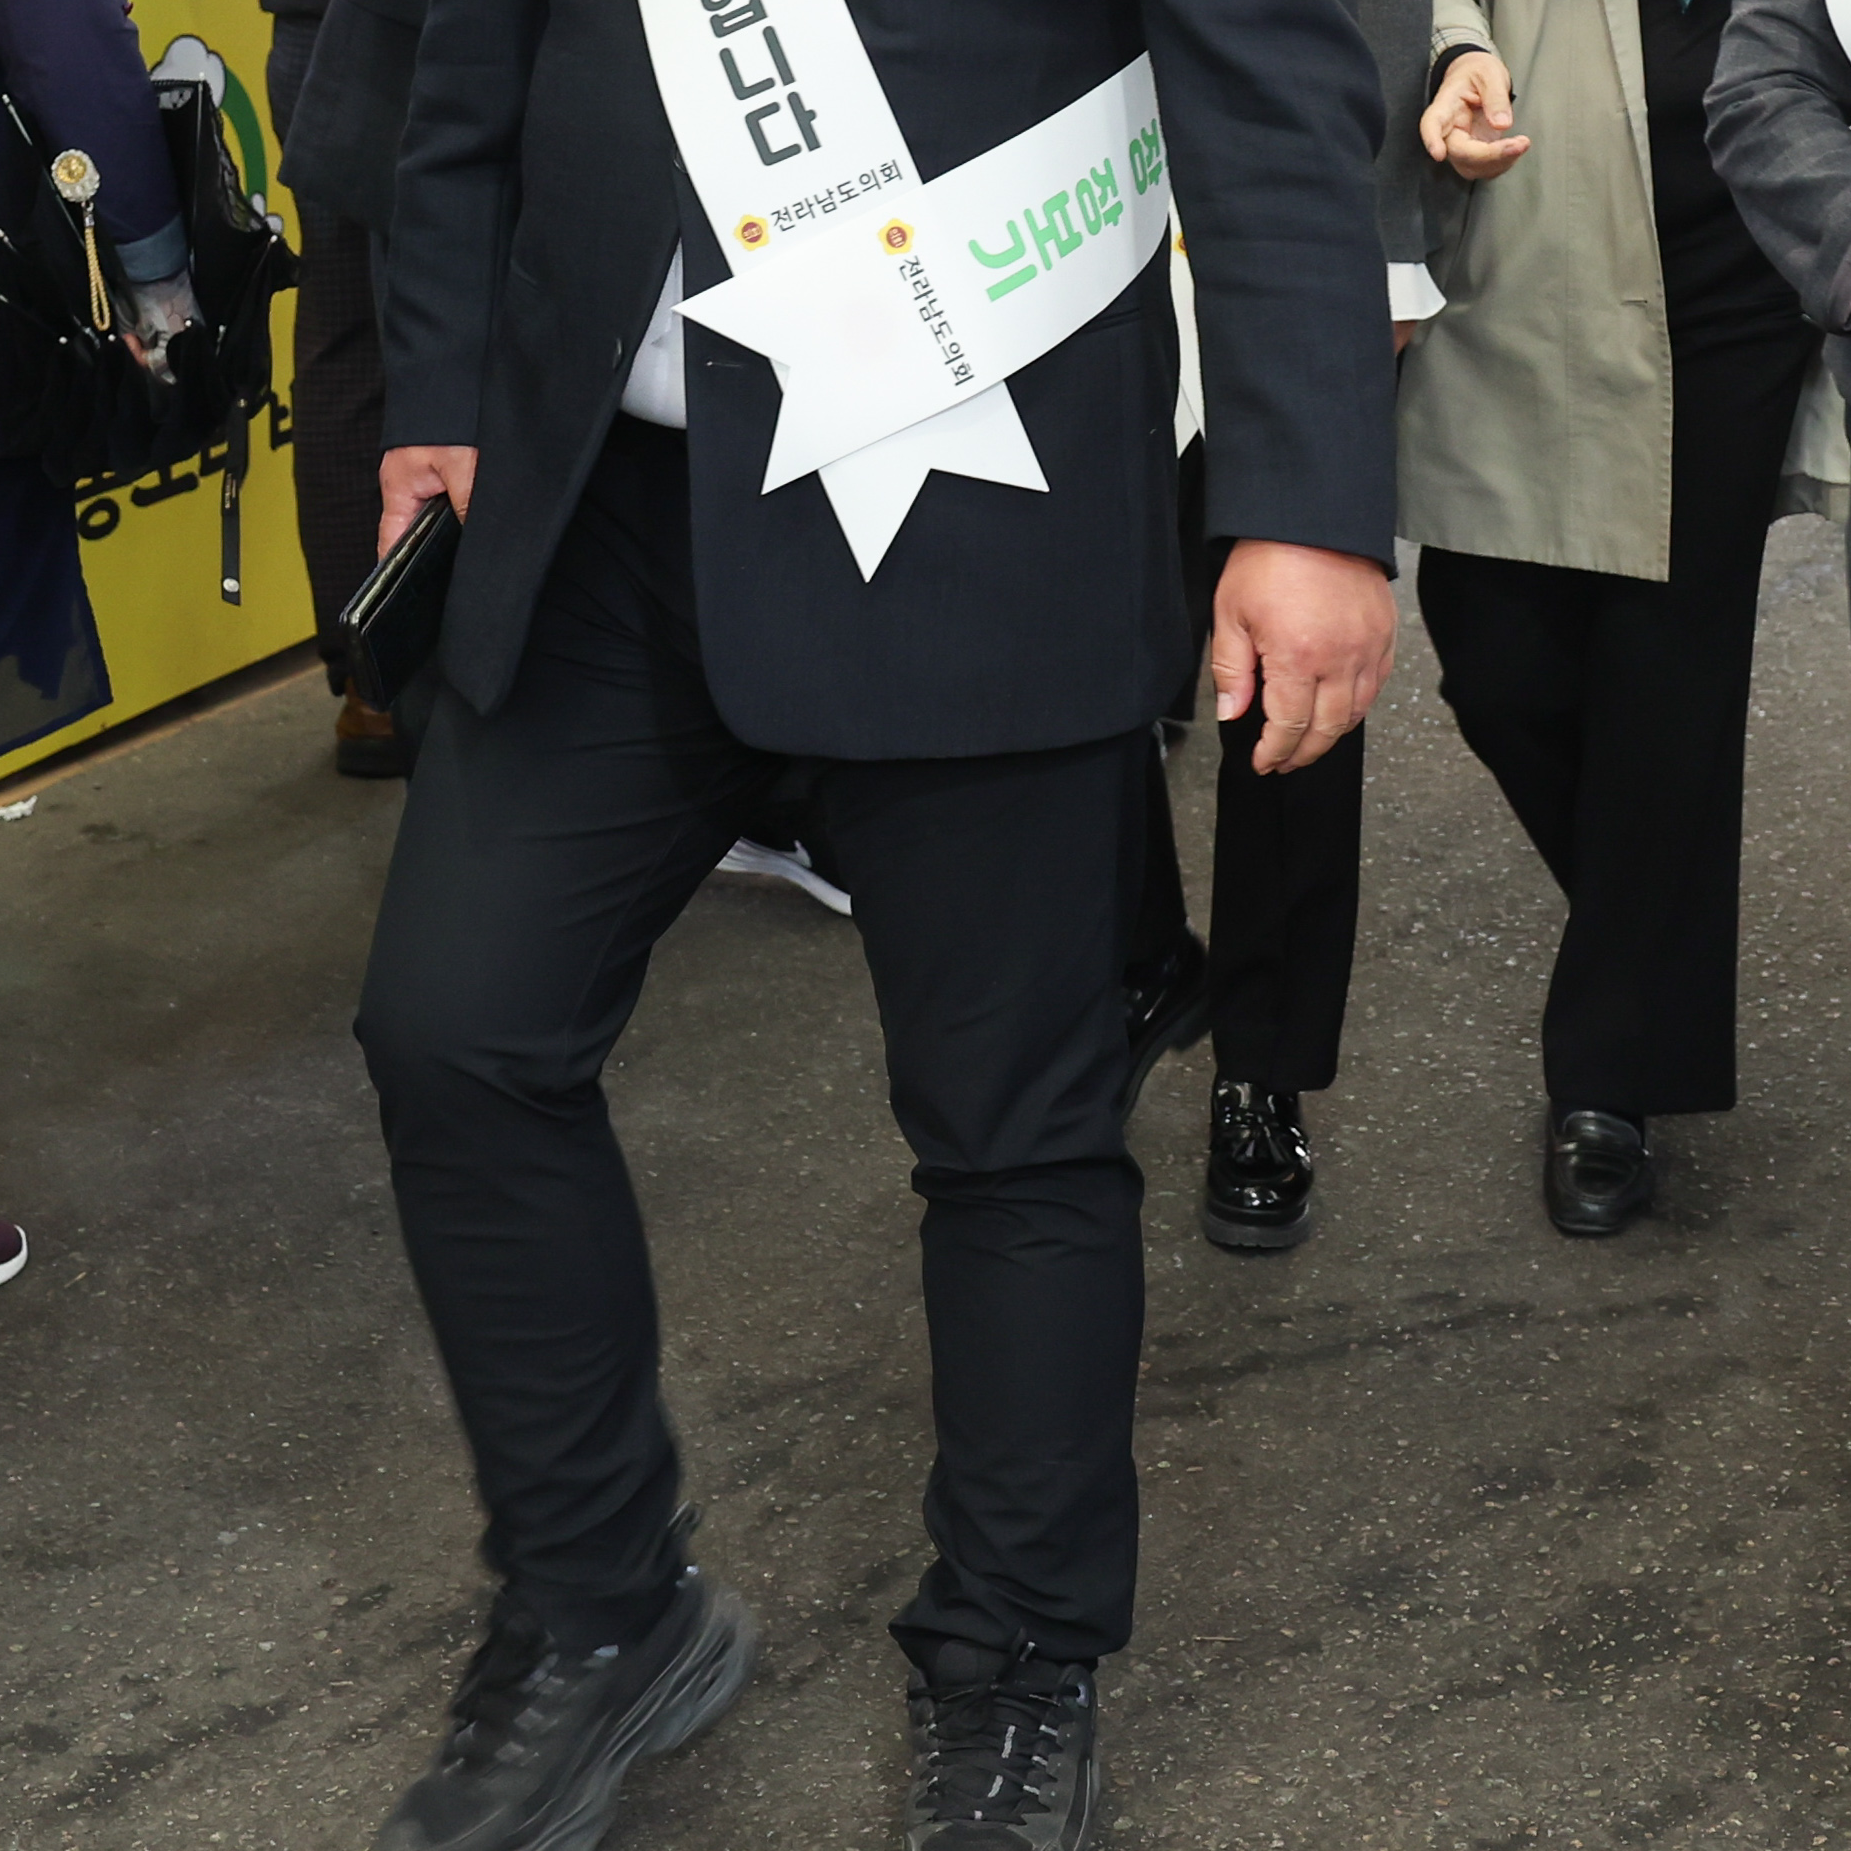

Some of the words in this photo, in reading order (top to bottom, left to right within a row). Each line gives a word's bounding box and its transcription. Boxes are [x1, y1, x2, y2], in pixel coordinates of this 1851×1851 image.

[769, 157, 905, 235] 전라남도의회
[968, 156, 1124, 304] 장보기
[898, 255, 976, 387] 전라남도의회
